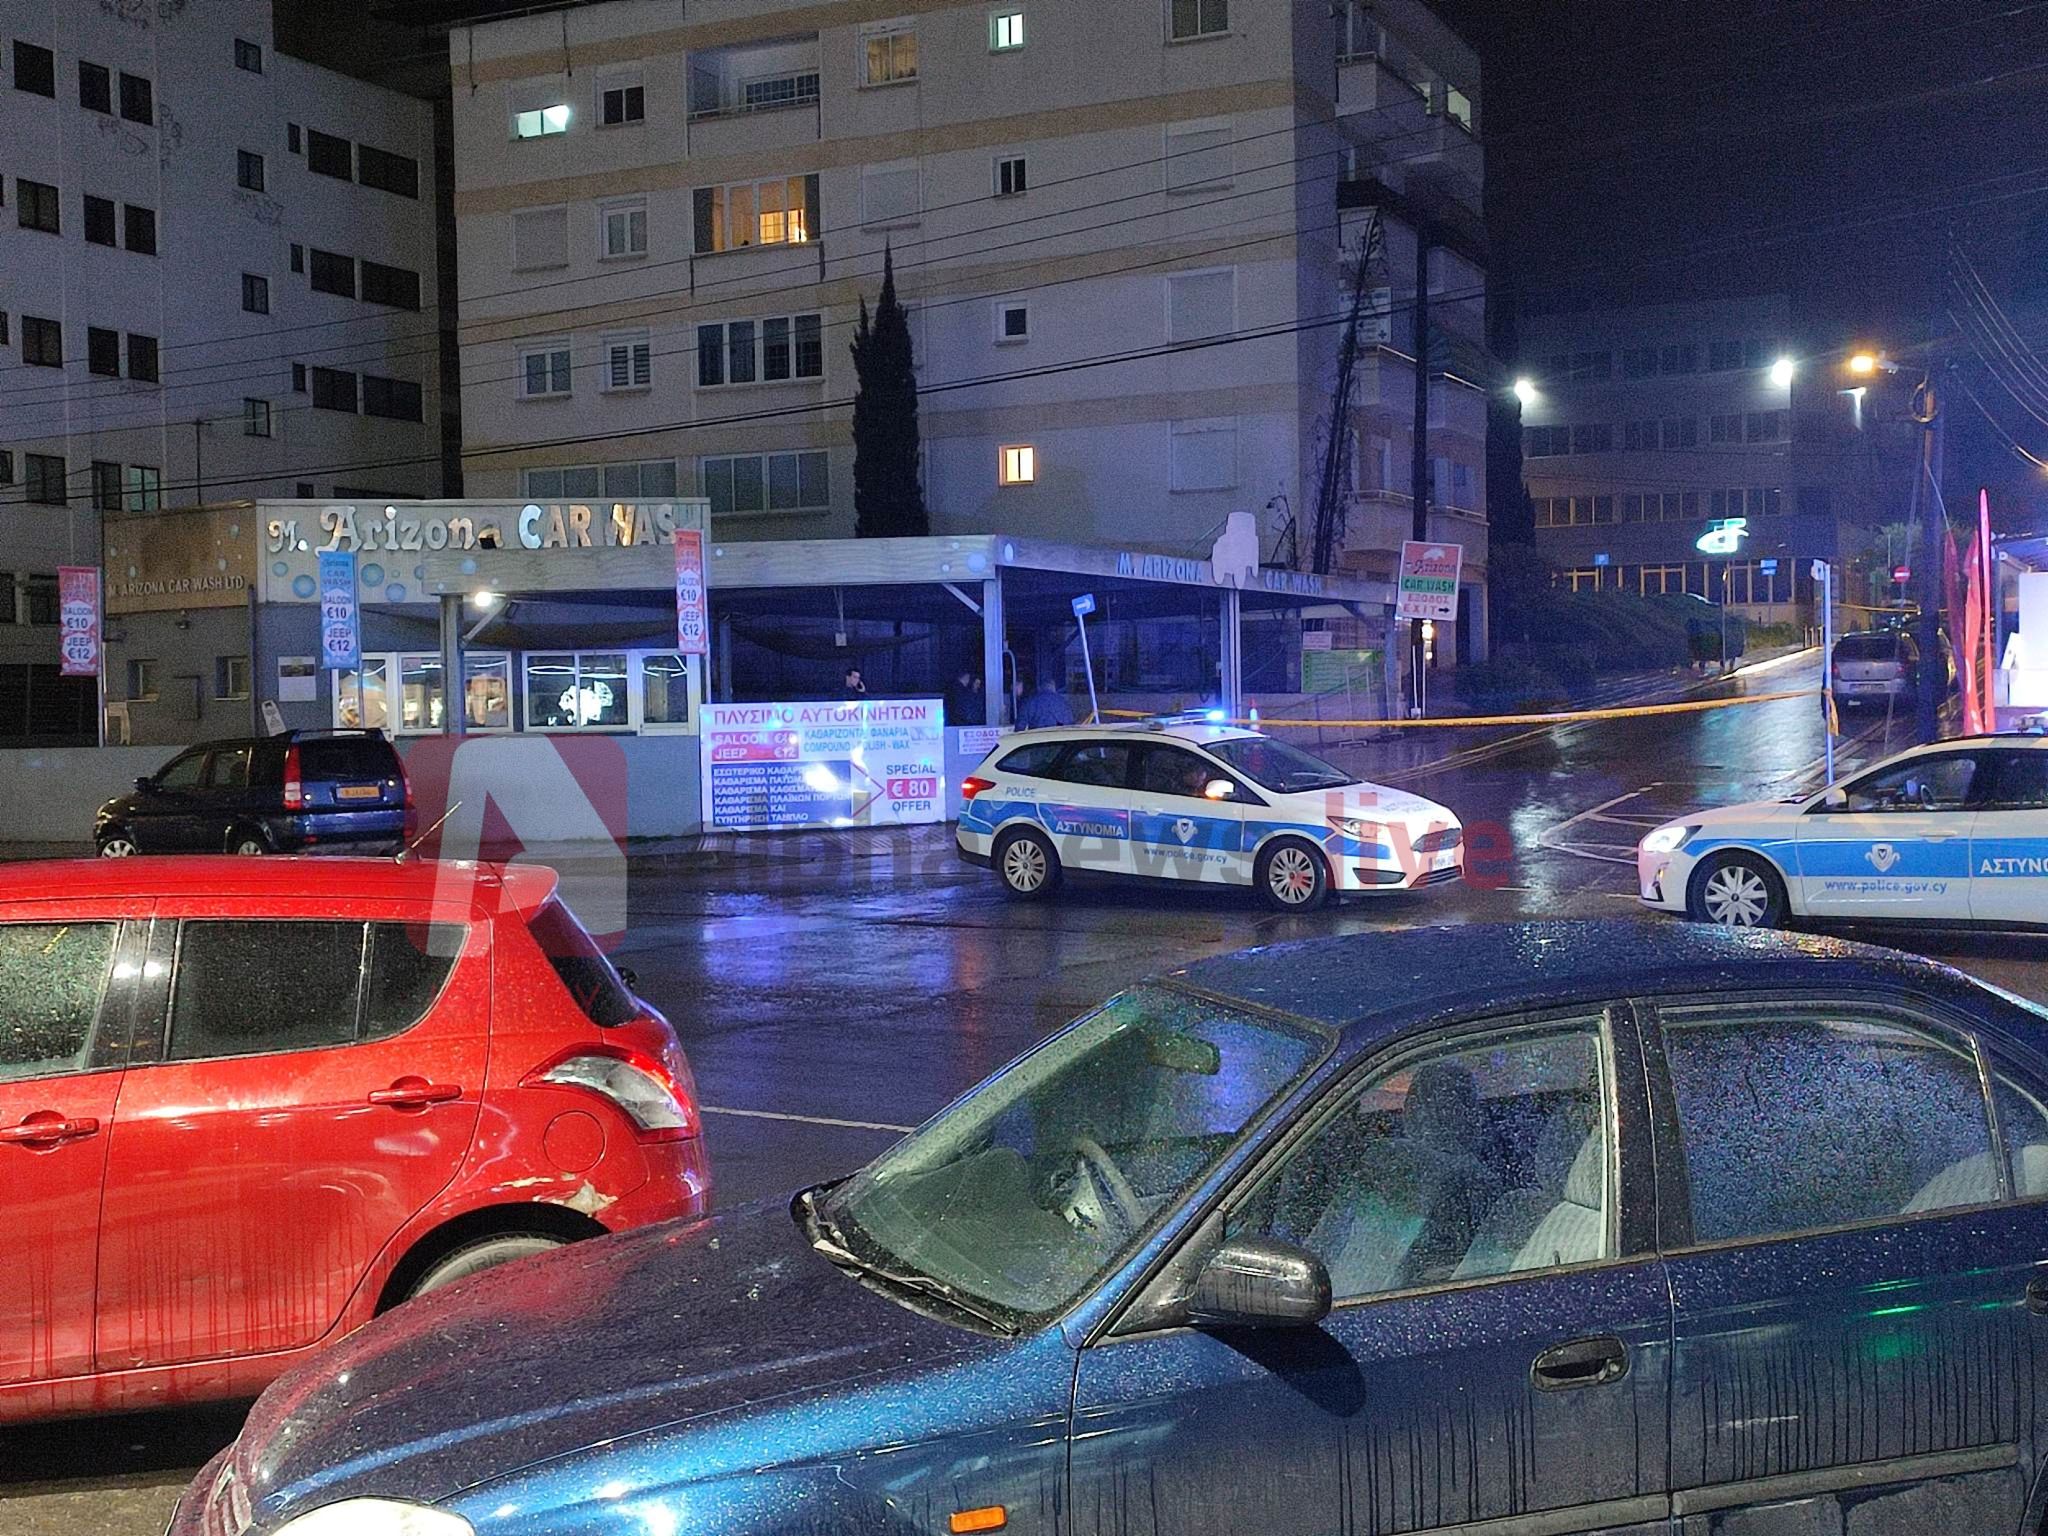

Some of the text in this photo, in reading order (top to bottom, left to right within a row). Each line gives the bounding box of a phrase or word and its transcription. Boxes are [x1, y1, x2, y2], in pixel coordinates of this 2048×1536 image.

[268, 520, 308, 552] M.
[315, 505, 504, 557] Arizona
[518, 504, 592, 549] CAR
[1118, 552, 1136, 575] M.
[1265, 571, 1288, 590] CAR
[1292, 575, 1322, 593] WASH
[121, 581, 166, 597] ARIZONA
[168, 579, 190, 593] CAR
[192, 577, 223, 592] WASH
[225, 575, 244, 589] LTD
[1405, 579, 1455, 592] CAR WASH
[681, 589, 697, 601] €10
[327, 607, 347, 618] €10
[682, 611, 700, 620] JEEP
[1403, 603, 1437, 616] EXIT
[67, 618, 88, 628] €10
[328, 628, 352, 637] JEEP
[682, 623, 699, 636] €12
[66, 637, 91, 646] JEEP
[328, 640, 350, 651] €12
[67, 648, 90, 659] €12
[800, 705, 926, 722] ΑΥΤΟΚΙΝΗΤΩΝ
[716, 733, 769, 745] SALOON
[803, 742, 851, 752] COMPOUND
[893, 740, 911, 750] WAX
[715, 746, 797, 759] JEEP €12
[886, 764, 936, 775] SPECIAL
[908, 780, 930, 797] 80
[1006, 787, 1036, 798] POLICE
[892, 801, 931, 812] OFFER
[1055, 820, 1124, 836] ΑΣΤΥΝΟΜΙΑ
[1143, 847, 1228, 864] www.police.gov.cy
[1824, 880, 1948, 895] www.police.gov.cy
